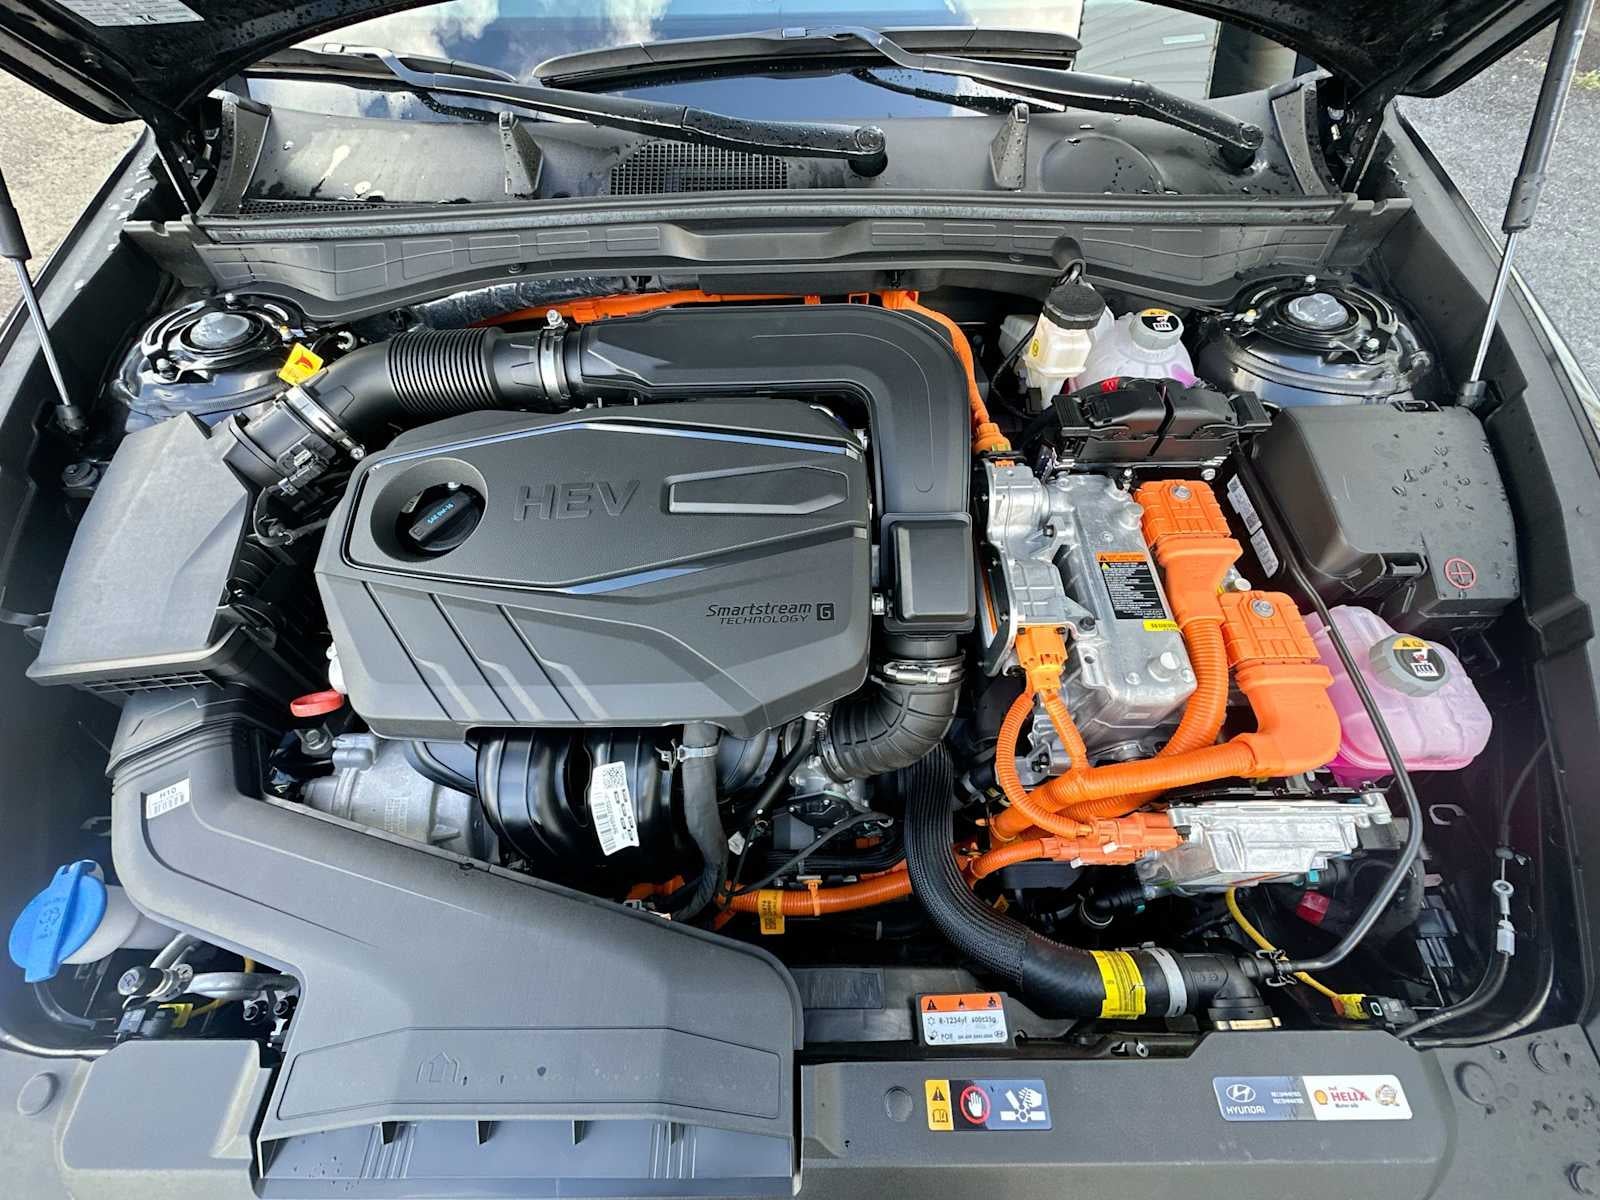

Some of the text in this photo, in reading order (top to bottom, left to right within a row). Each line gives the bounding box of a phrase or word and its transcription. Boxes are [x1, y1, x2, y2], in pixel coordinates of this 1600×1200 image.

[513, 480, 641, 520] HEV
[706, 602, 834, 620] Smartstream G
[720, 615, 808, 625] TECHNOLOGY
[1331, 1090, 1369, 1102] HELIX
[1226, 1105, 1265, 1115] HYUNDAI
